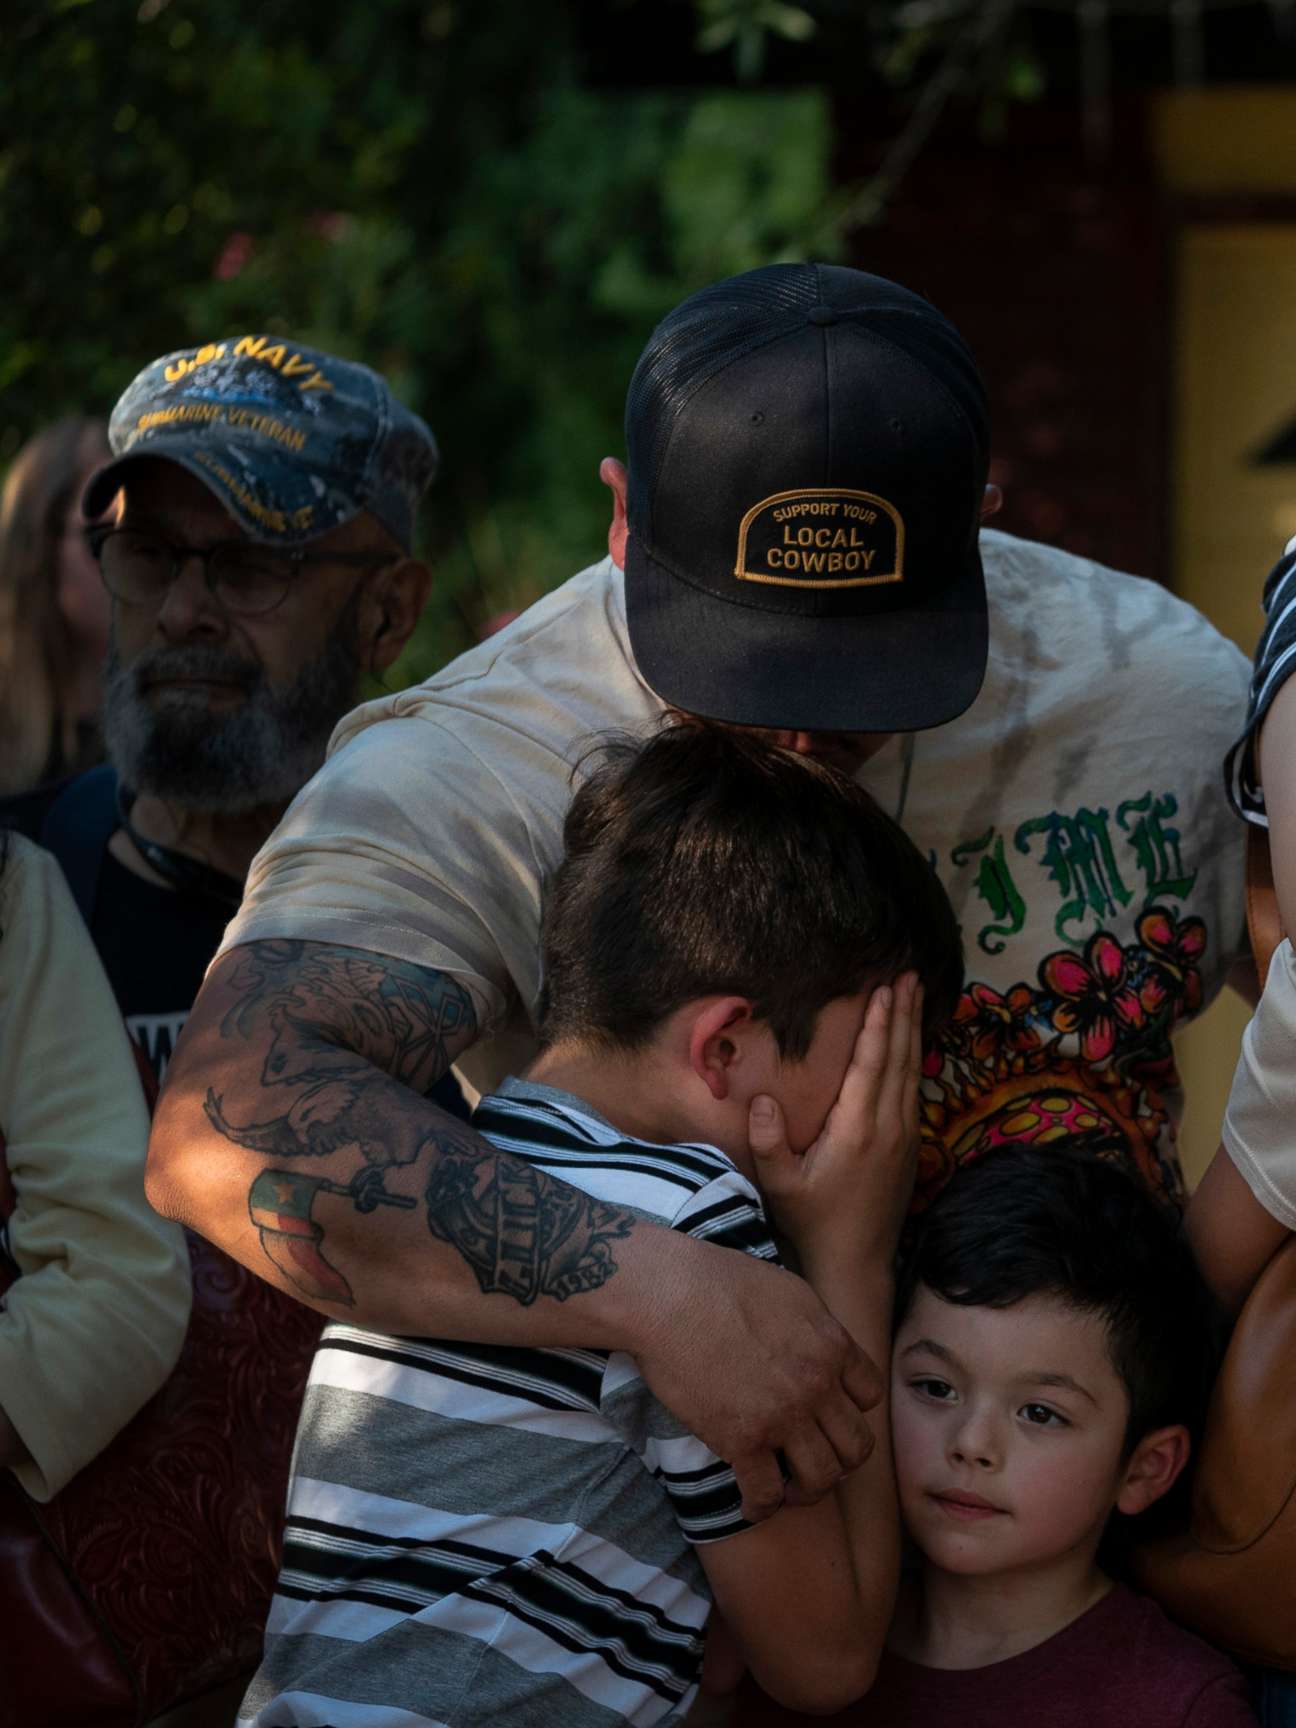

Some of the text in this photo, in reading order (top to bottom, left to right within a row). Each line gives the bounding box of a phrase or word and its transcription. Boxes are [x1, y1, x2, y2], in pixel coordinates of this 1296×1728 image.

[233, 336, 335, 392] NAVY
[227, 405, 307, 451] VETERAN
[772, 502, 879, 526] SUPPORT YOUR
[783, 525, 865, 549] LOCAL
[766, 547, 878, 574] COWBOY
[928, 791, 1199, 955] IME
